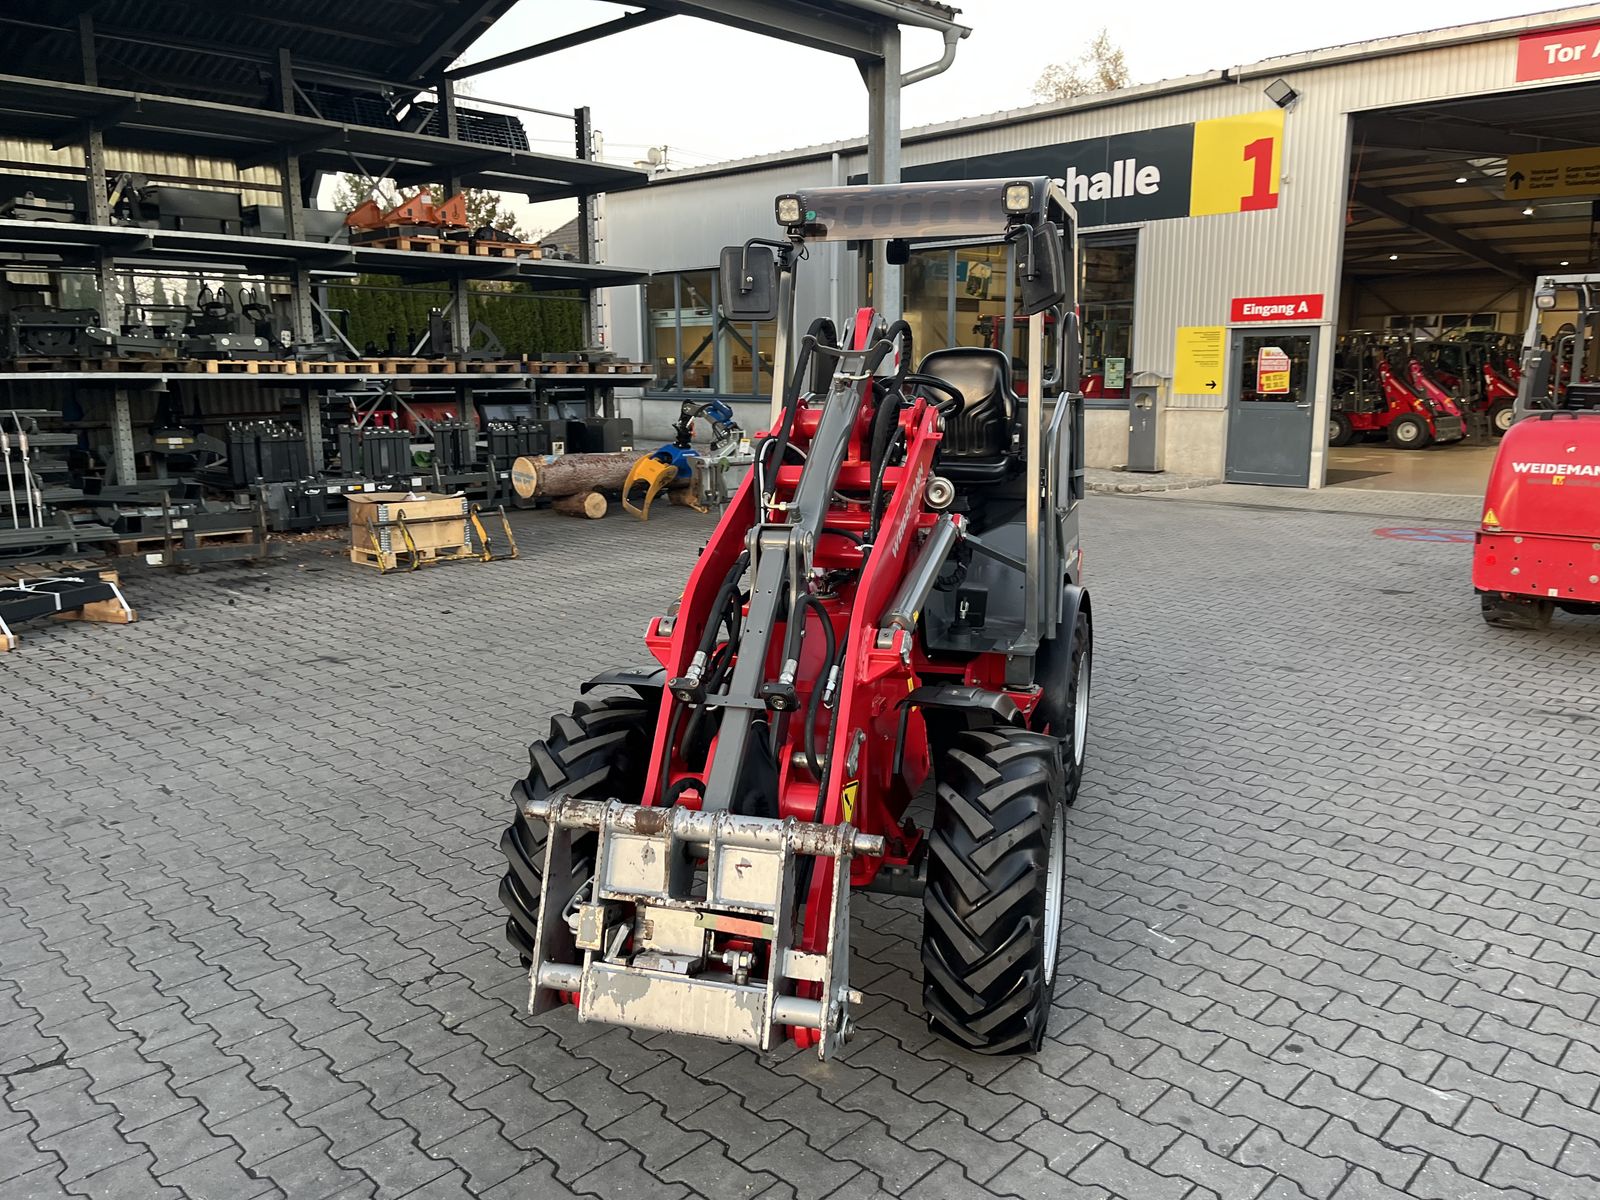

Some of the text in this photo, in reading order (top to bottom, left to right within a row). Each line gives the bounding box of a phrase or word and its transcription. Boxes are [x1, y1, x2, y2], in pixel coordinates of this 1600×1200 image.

[1543, 43, 1587, 65] Tor
[1240, 137, 1279, 212] 1
[1243, 300, 1309, 317] Eingang A
